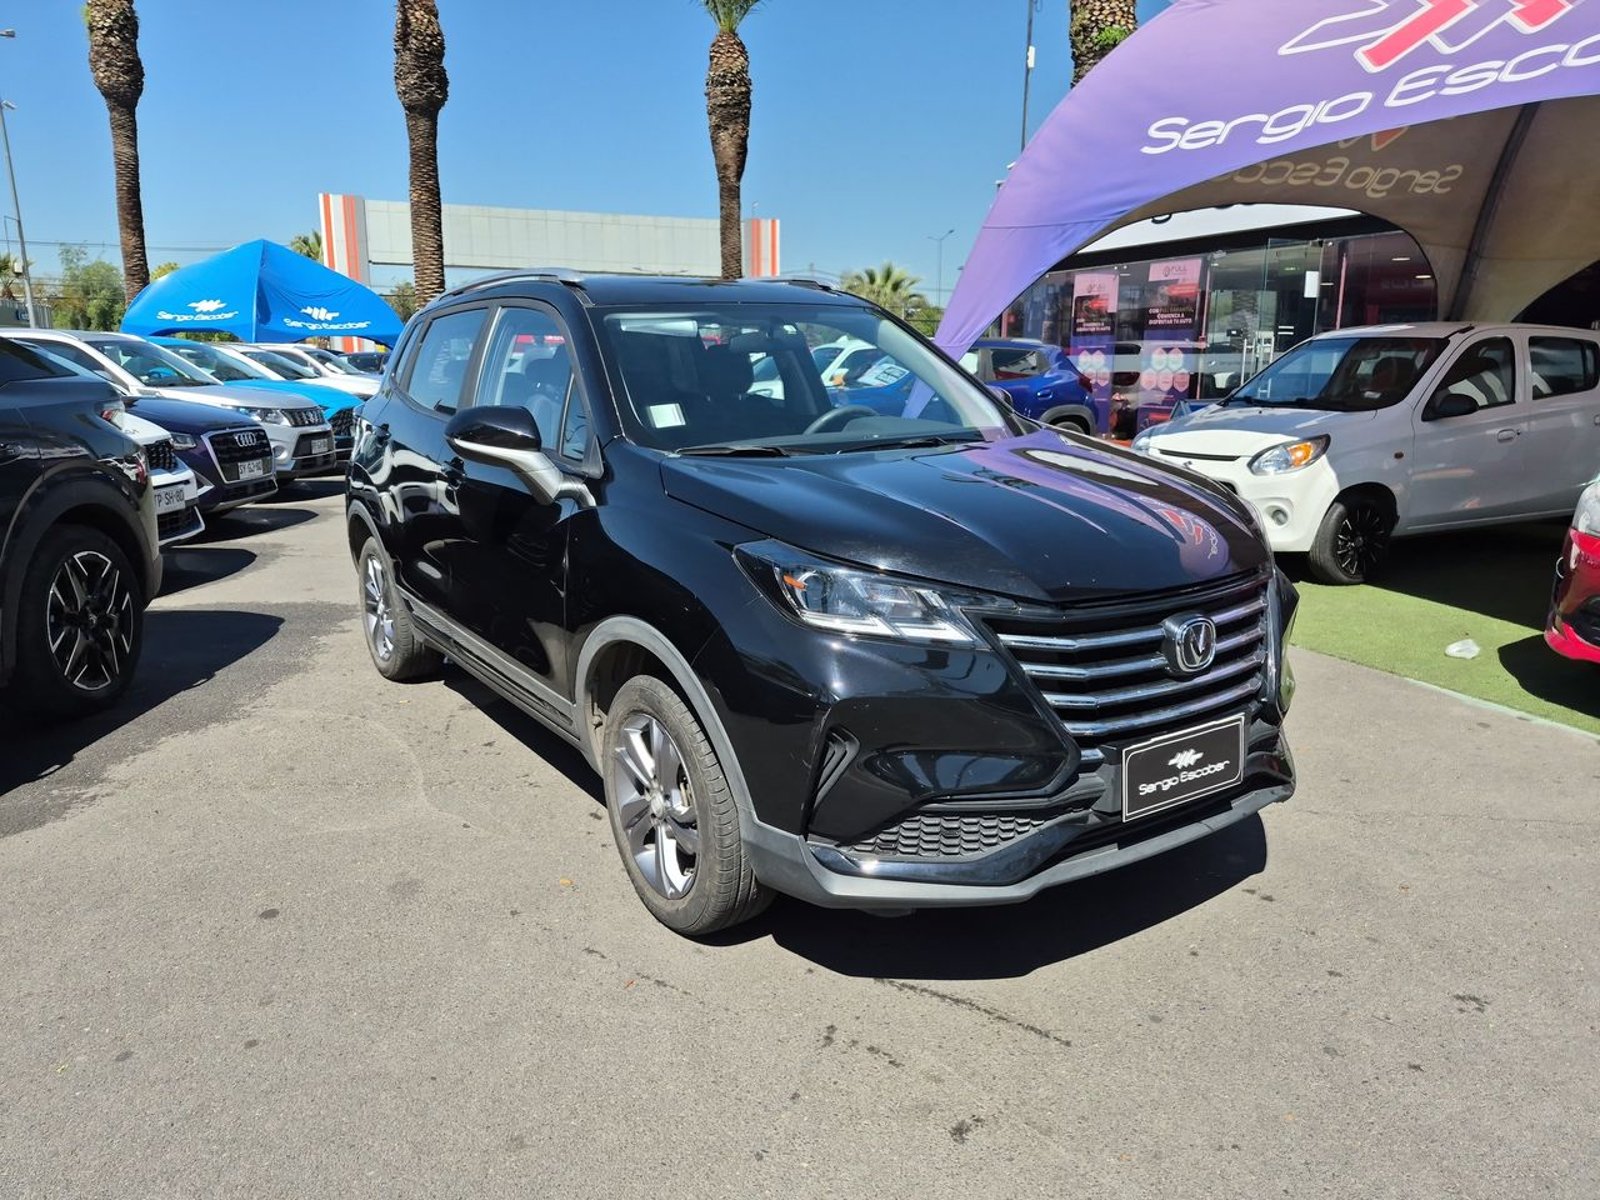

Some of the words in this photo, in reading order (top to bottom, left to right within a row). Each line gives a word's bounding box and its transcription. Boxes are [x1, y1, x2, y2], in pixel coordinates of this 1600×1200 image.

[1140, 91, 1373, 155] Sergio
[1138, 776, 1179, 796] Sergio
[1180, 760, 1230, 783] Escobar
